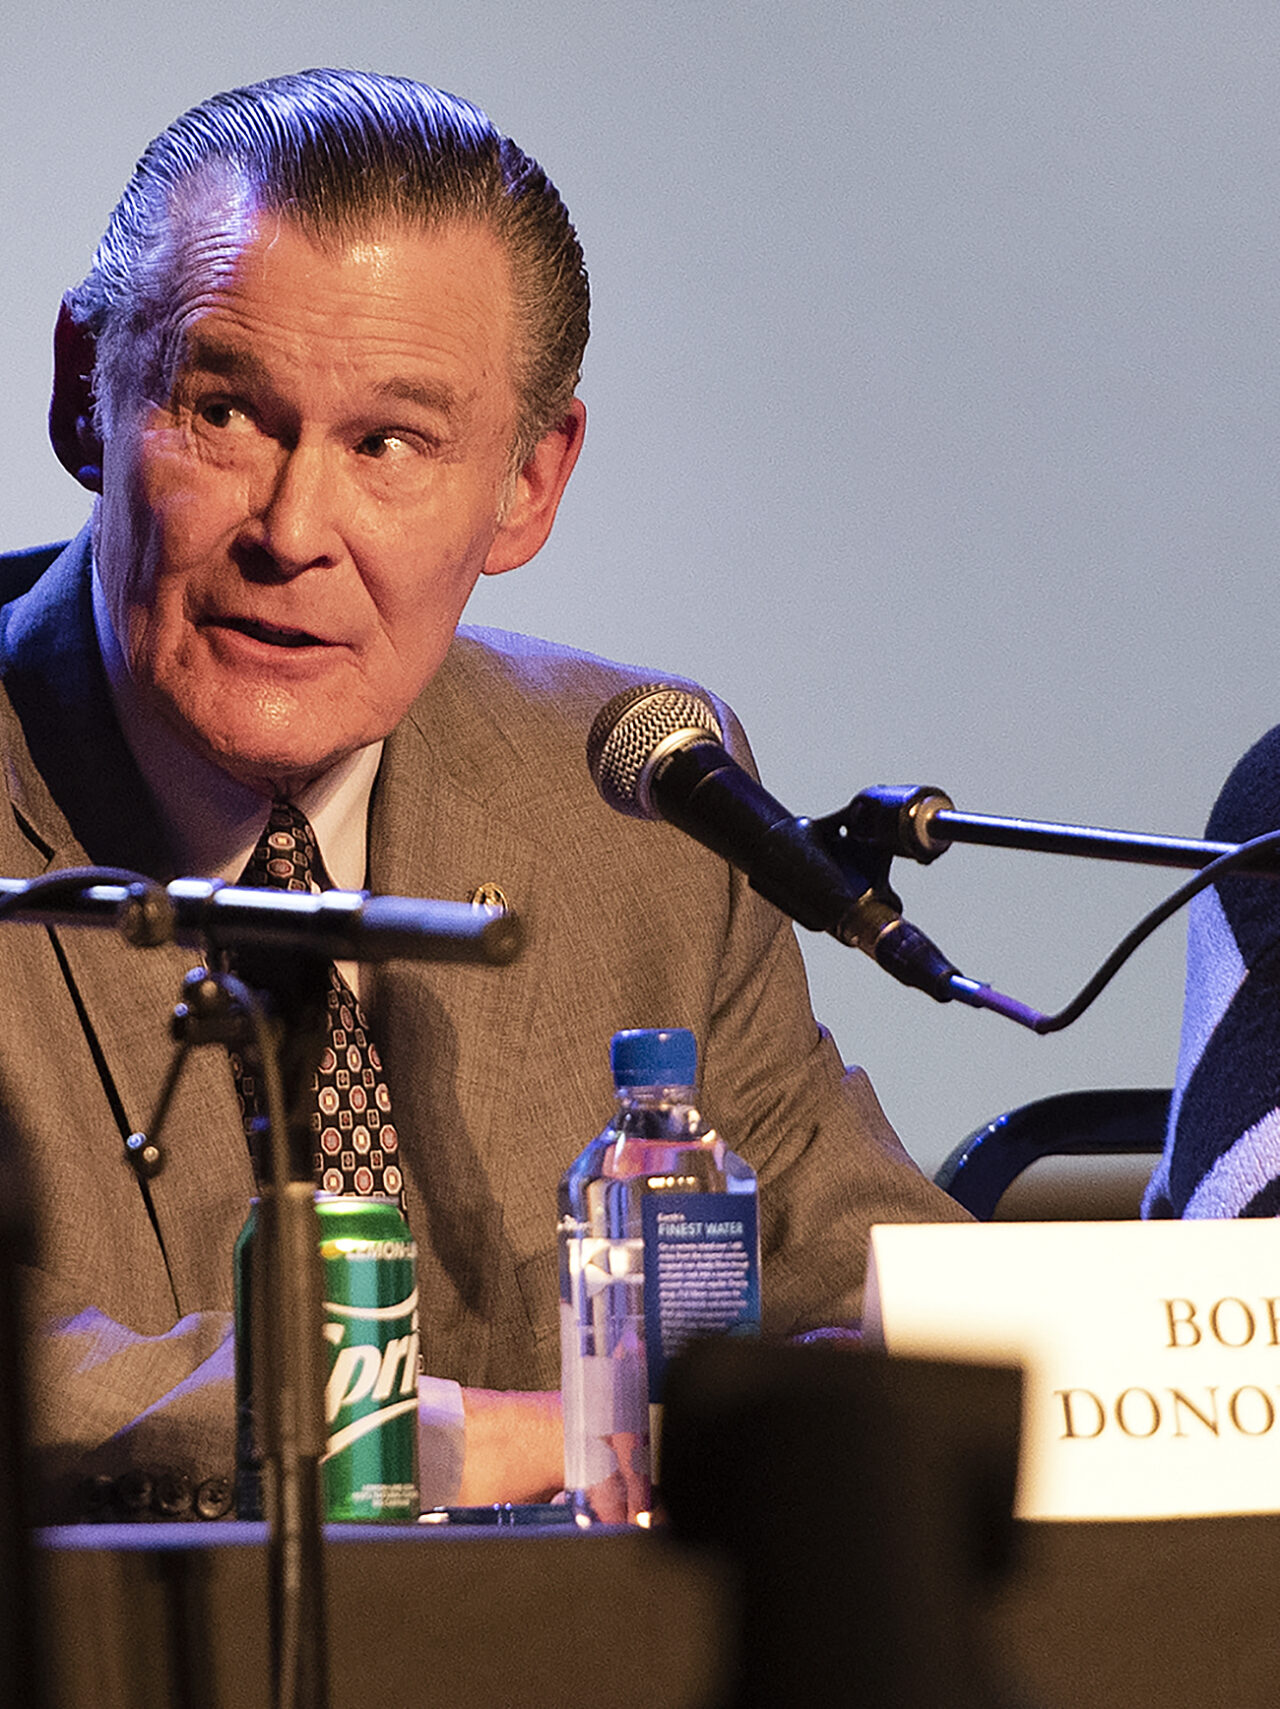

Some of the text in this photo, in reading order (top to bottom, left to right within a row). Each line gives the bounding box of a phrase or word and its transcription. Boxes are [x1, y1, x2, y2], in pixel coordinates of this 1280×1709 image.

[657, 1221, 744, 1237] FINEST WATER
[321, 1309, 418, 1424] pri
[1054, 1385, 1280, 1440] DONO
